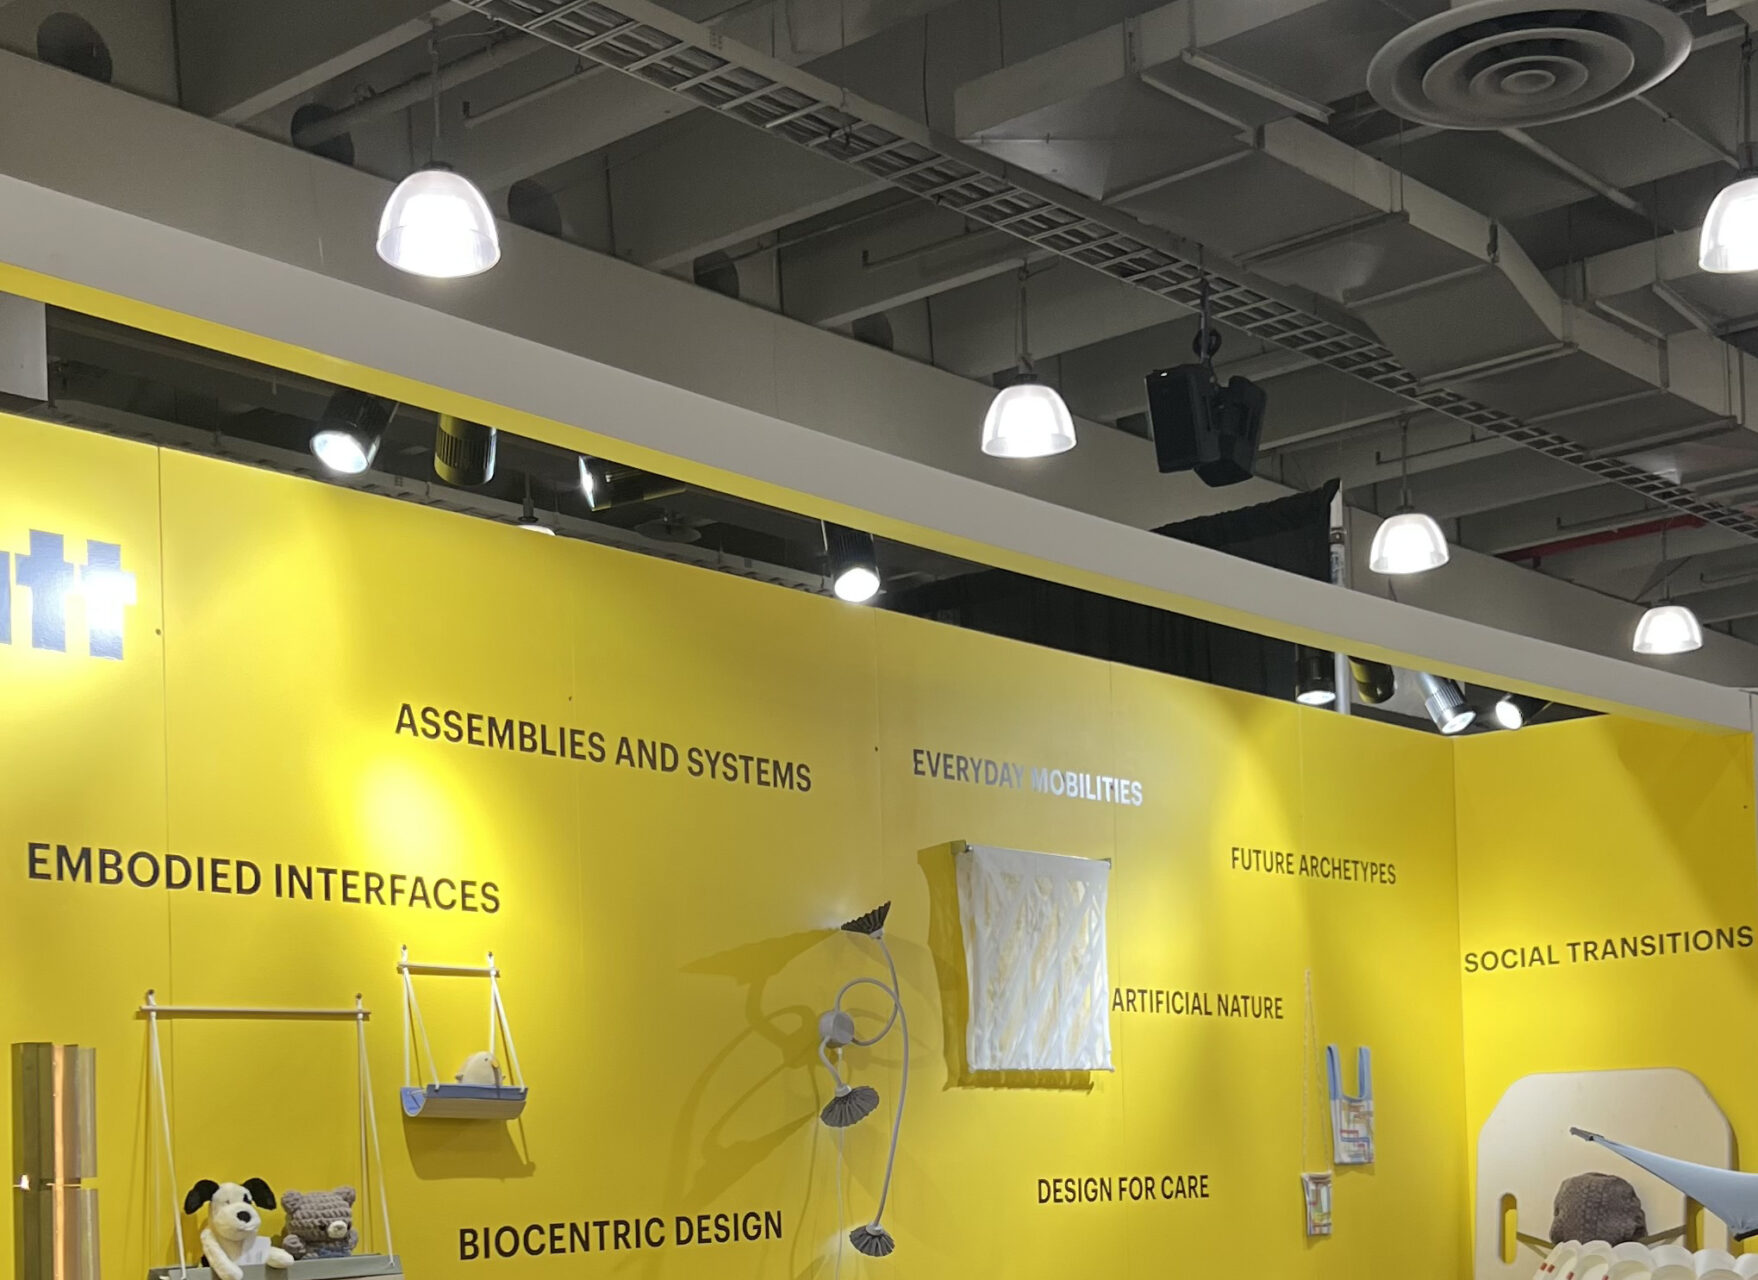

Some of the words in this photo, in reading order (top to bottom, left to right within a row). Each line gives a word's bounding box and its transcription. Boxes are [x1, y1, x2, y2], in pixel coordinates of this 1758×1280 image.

[395, 703, 606, 764] ASSEMBLIES
[615, 736, 679, 773] AND
[687, 746, 813, 793] SYSTEMS
[912, 748, 1025, 790] EVERYDAY
[1029, 767, 1145, 807] MOBILITIES
[27, 842, 262, 896] EMBODIED
[274, 863, 501, 915] INTERFACES
[1230, 847, 1295, 876] FUTURE
[1298, 854, 1397, 886] ARCHETYPES
[1463, 944, 1560, 974] SOCIAL
[1566, 925, 1754, 964] TRANSITIONS
[1111, 988, 1213, 1017] ARTIFICIAL
[1216, 994, 1284, 1020] NATURE
[1037, 1177, 1113, 1205] DESIGN
[1118, 1175, 1156, 1202] FOR
[1160, 1173, 1210, 1201] CARE
[459, 1217, 665, 1262] BIOCENTRIC
[674, 1210, 783, 1248] DESIGN
